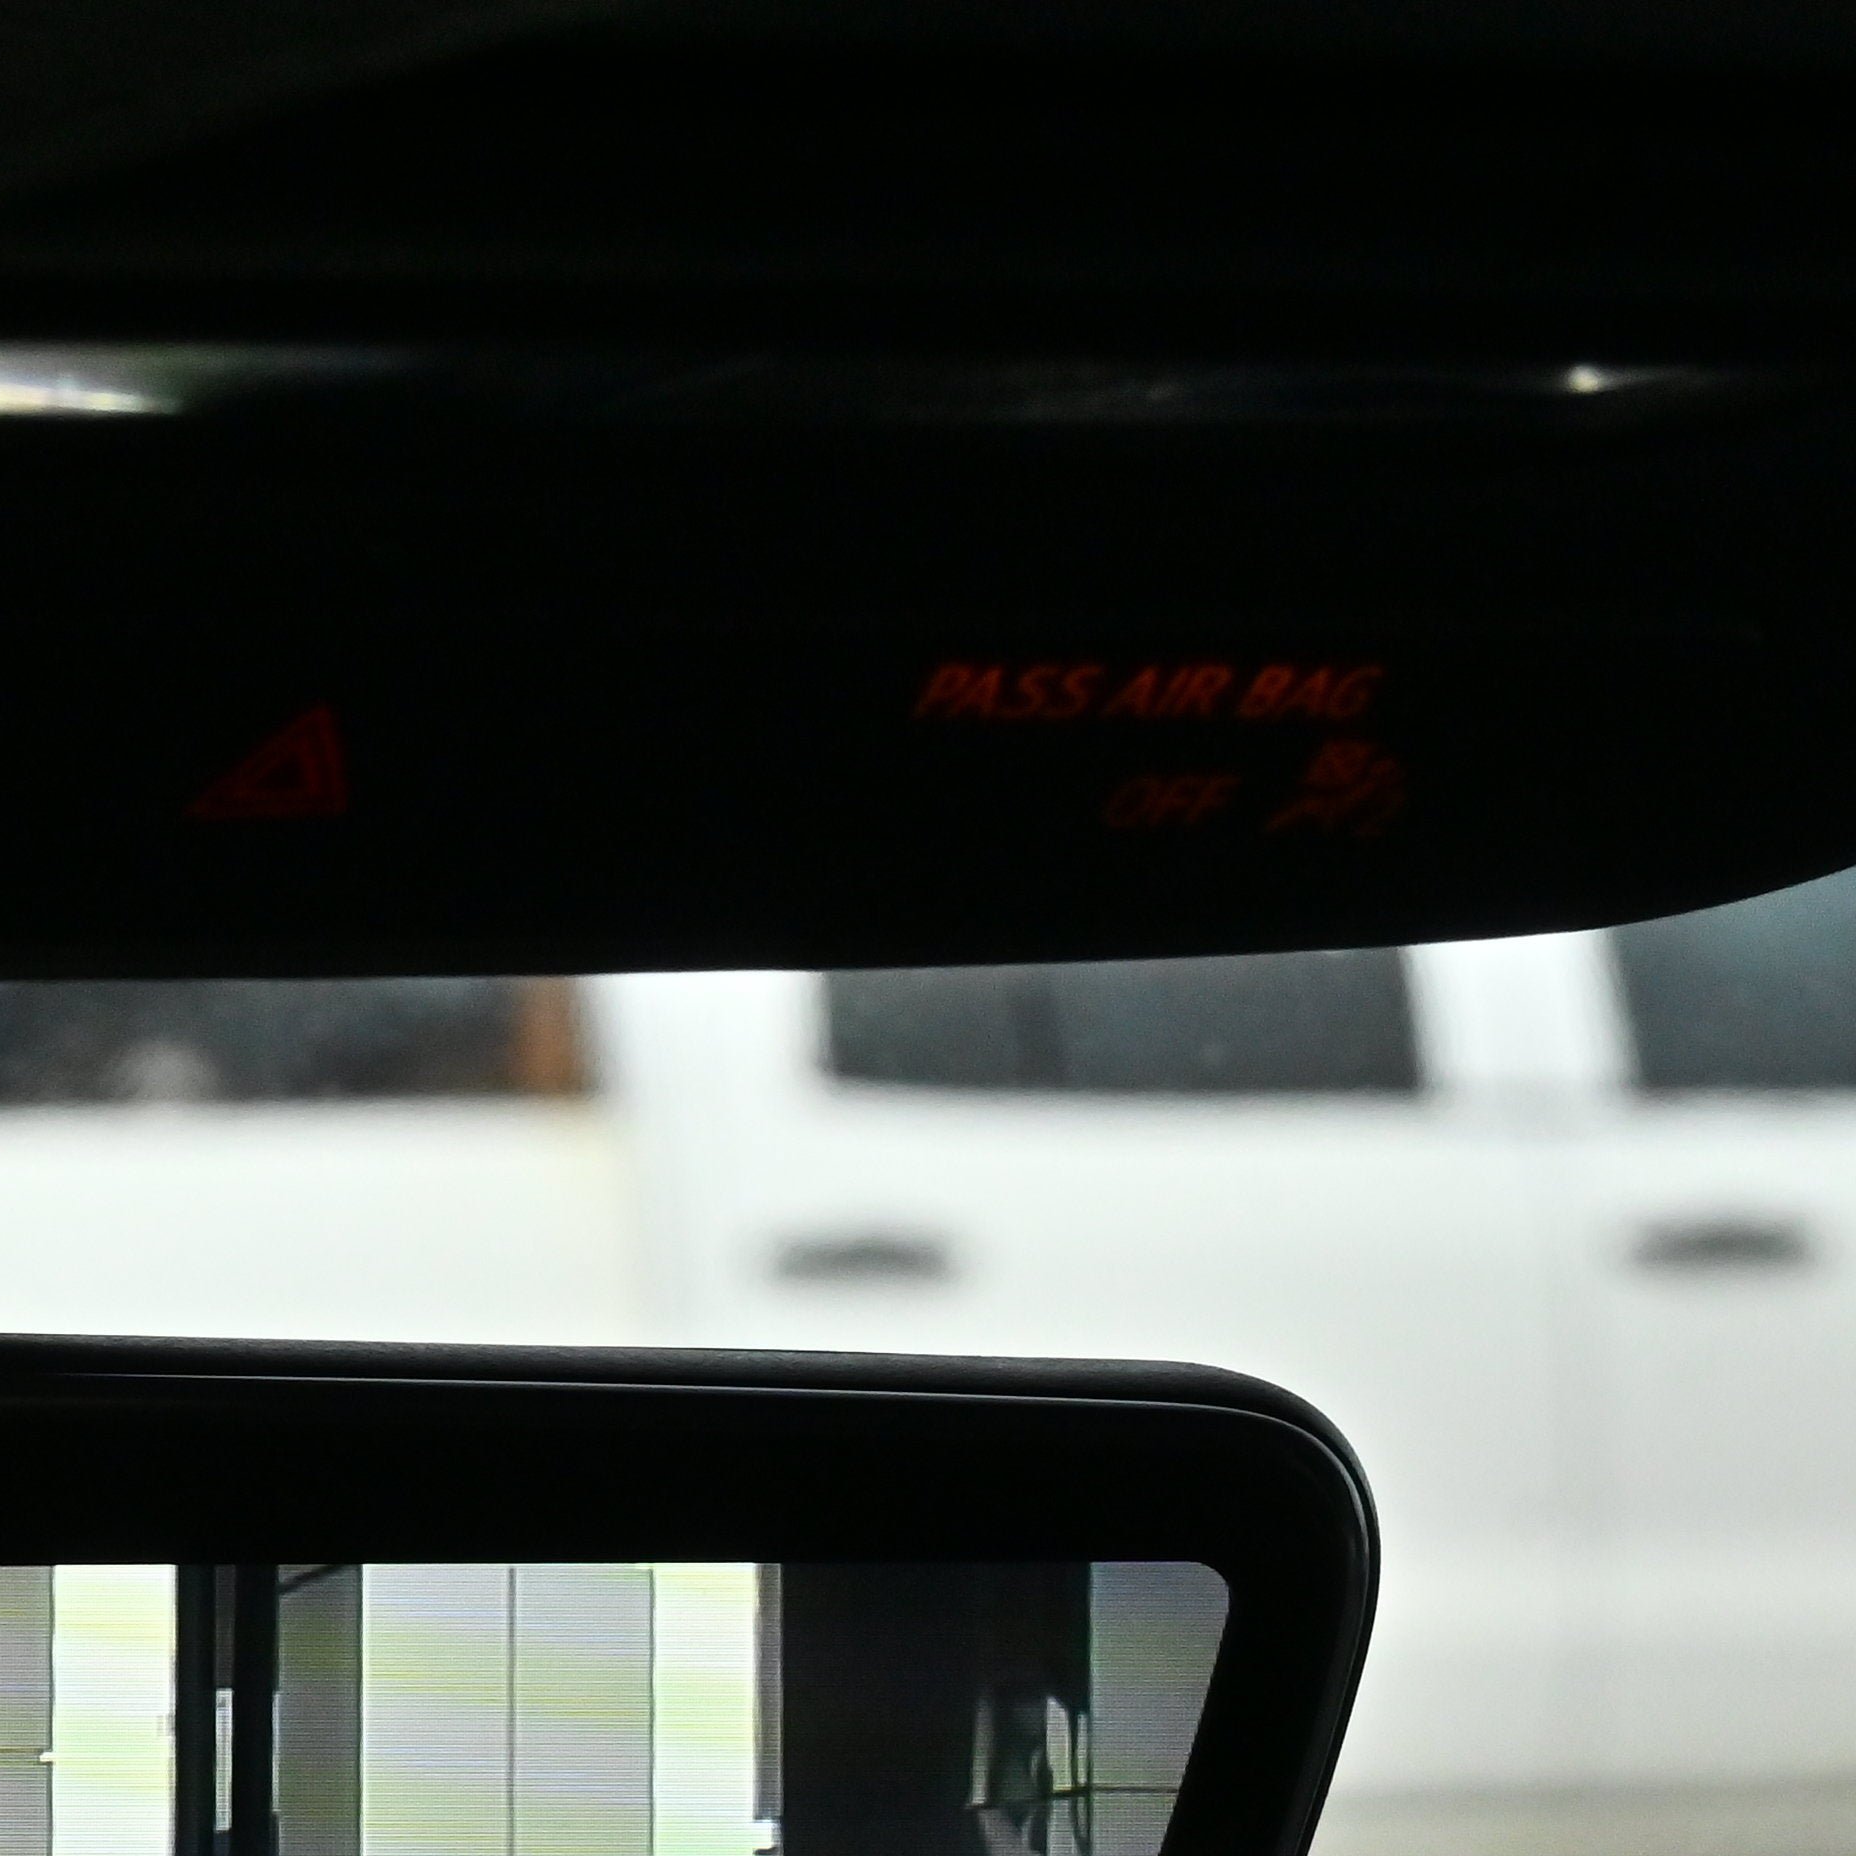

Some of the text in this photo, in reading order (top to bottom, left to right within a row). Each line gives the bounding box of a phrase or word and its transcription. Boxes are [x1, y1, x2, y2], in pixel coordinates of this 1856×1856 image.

[912, 664, 1385, 720] PASS AIR BAG
[1103, 773, 1243, 830] OFF
